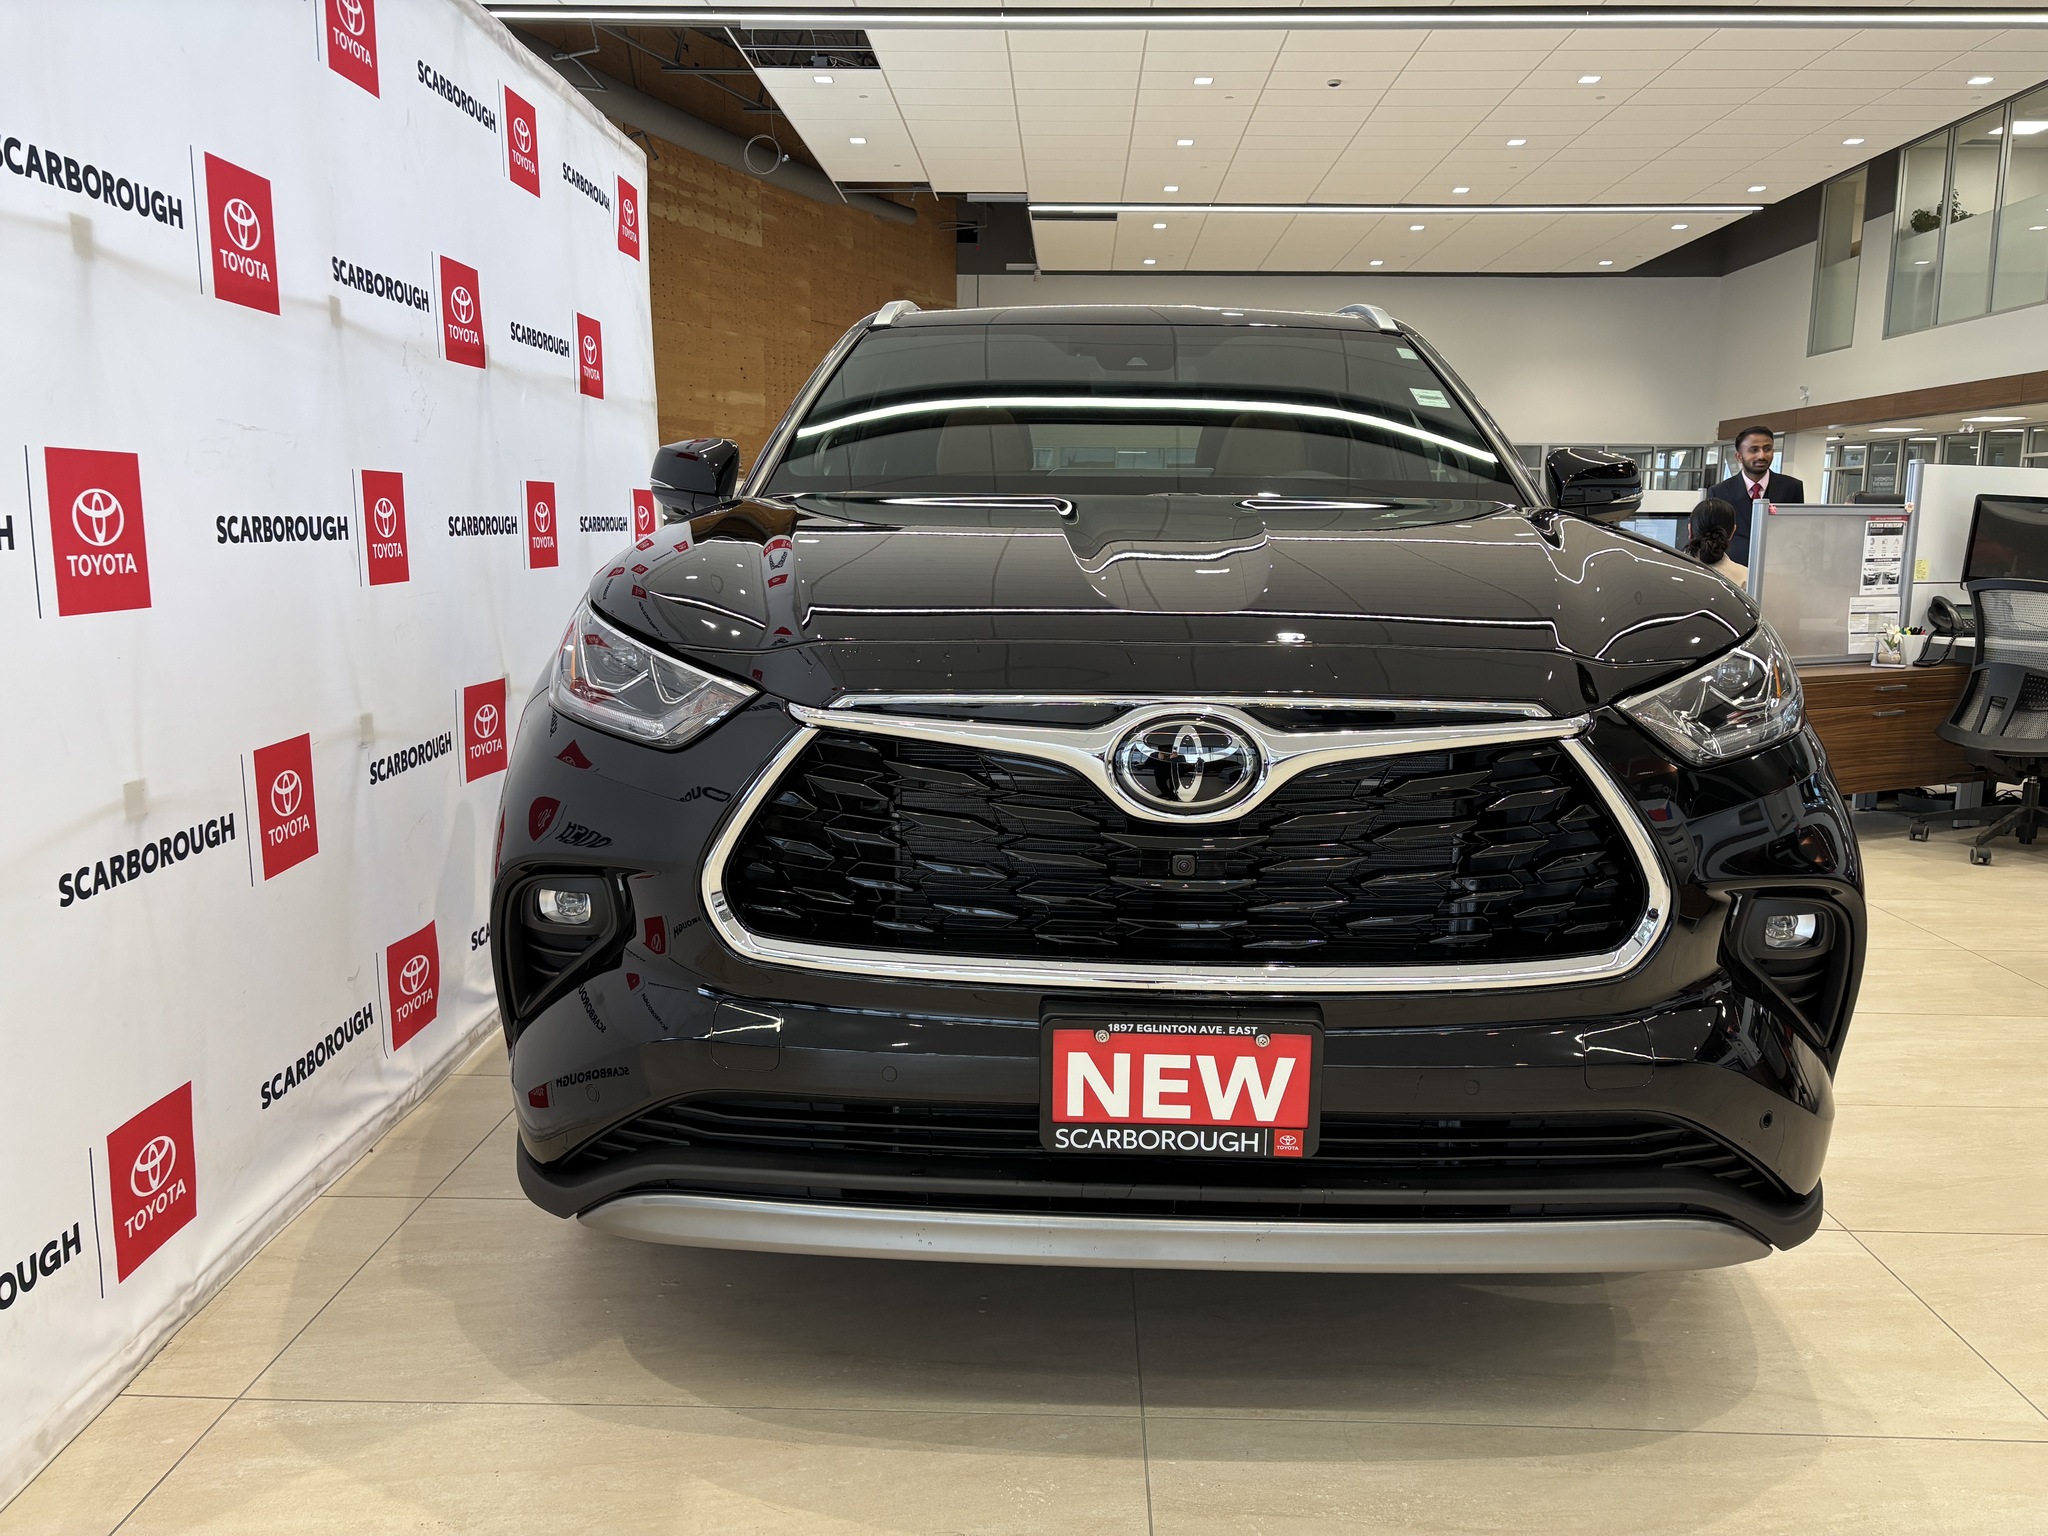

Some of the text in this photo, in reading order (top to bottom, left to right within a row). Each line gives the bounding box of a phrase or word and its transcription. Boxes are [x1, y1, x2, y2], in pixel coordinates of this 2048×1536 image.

[332, 26, 373, 68] TOYOTA
[417, 59, 497, 134] SCARBOROUGH
[511, 149, 537, 176] TOYOTA
[0, 134, 184, 229] CARBOROUGH
[562, 162, 611, 213] SCARBOROUGH
[621, 225, 638, 244] TOYOTA
[220, 248, 271, 282] TOYOTA
[331, 256, 430, 313] SCARBOROUGH
[448, 323, 480, 346] TOYOTA
[510, 321, 570, 358] SCARBOROUGH
[583, 365, 601, 381] TOYOTA
[216, 515, 349, 543] SCARBOROUGH
[448, 515, 518, 537] SCARBOROUGH
[580, 516, 628, 533] SCARBOROUGH
[372, 542, 403, 559] TOYOTA
[532, 535, 555, 549] TOYOTA
[66, 553, 138, 577] TOYOTA
[370, 731, 452, 785] SCARBOROUGH
[470, 738, 502, 759] TOYOTA
[268, 814, 310, 846] TOYOTA
[58, 812, 236, 907] SCARBOROUGH
[396, 987, 433, 1022] TOYOTA
[1108, 1023, 1258, 1035] 1897 EGLINTON AVE. EAST
[261, 1002, 374, 1109] SCARBOROUGH
[1067, 1051, 1296, 1122] NEW
[1055, 1128, 1259, 1152] SCARBOROUGH
[124, 1178, 187, 1238] TOYOTA
